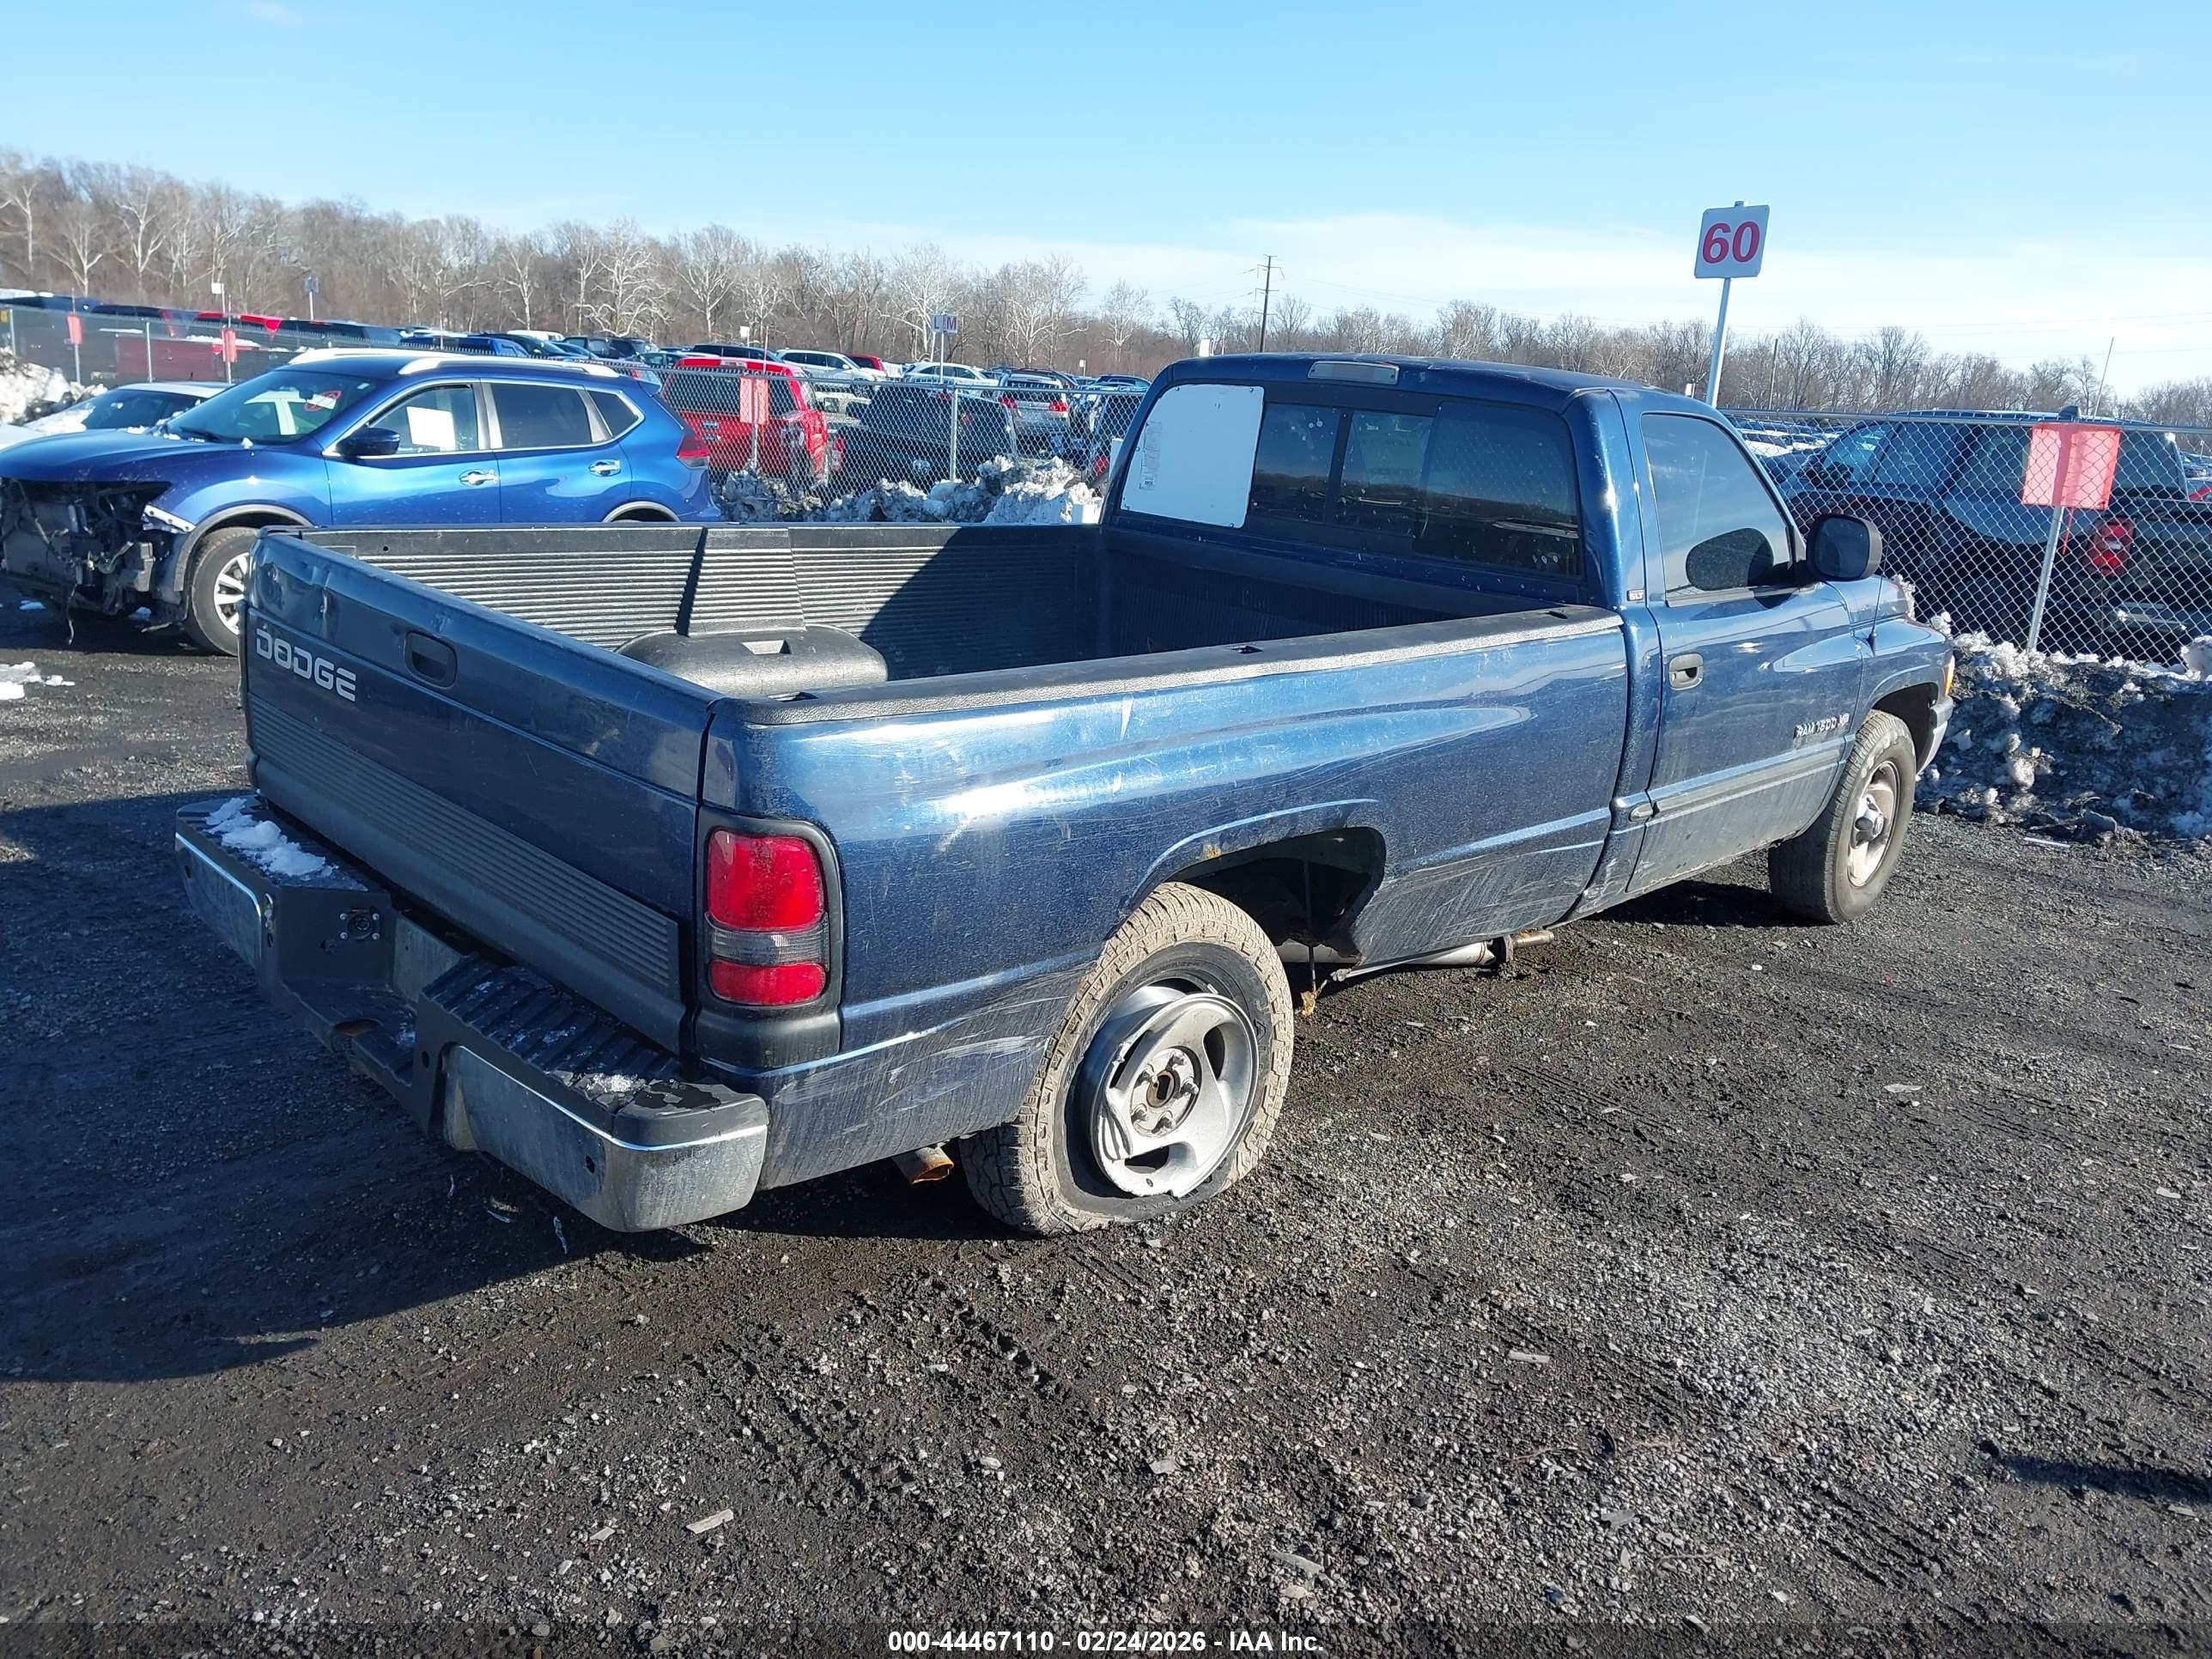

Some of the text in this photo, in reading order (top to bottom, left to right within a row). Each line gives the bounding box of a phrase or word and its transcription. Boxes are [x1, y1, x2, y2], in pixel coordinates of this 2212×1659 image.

[1702, 221, 1760, 264] 60
[946, 316, 957, 330] M
[256, 628, 356, 702] DODGE
[1796, 721, 1815, 738] RAM
[1816, 716, 1838, 732] 1500
